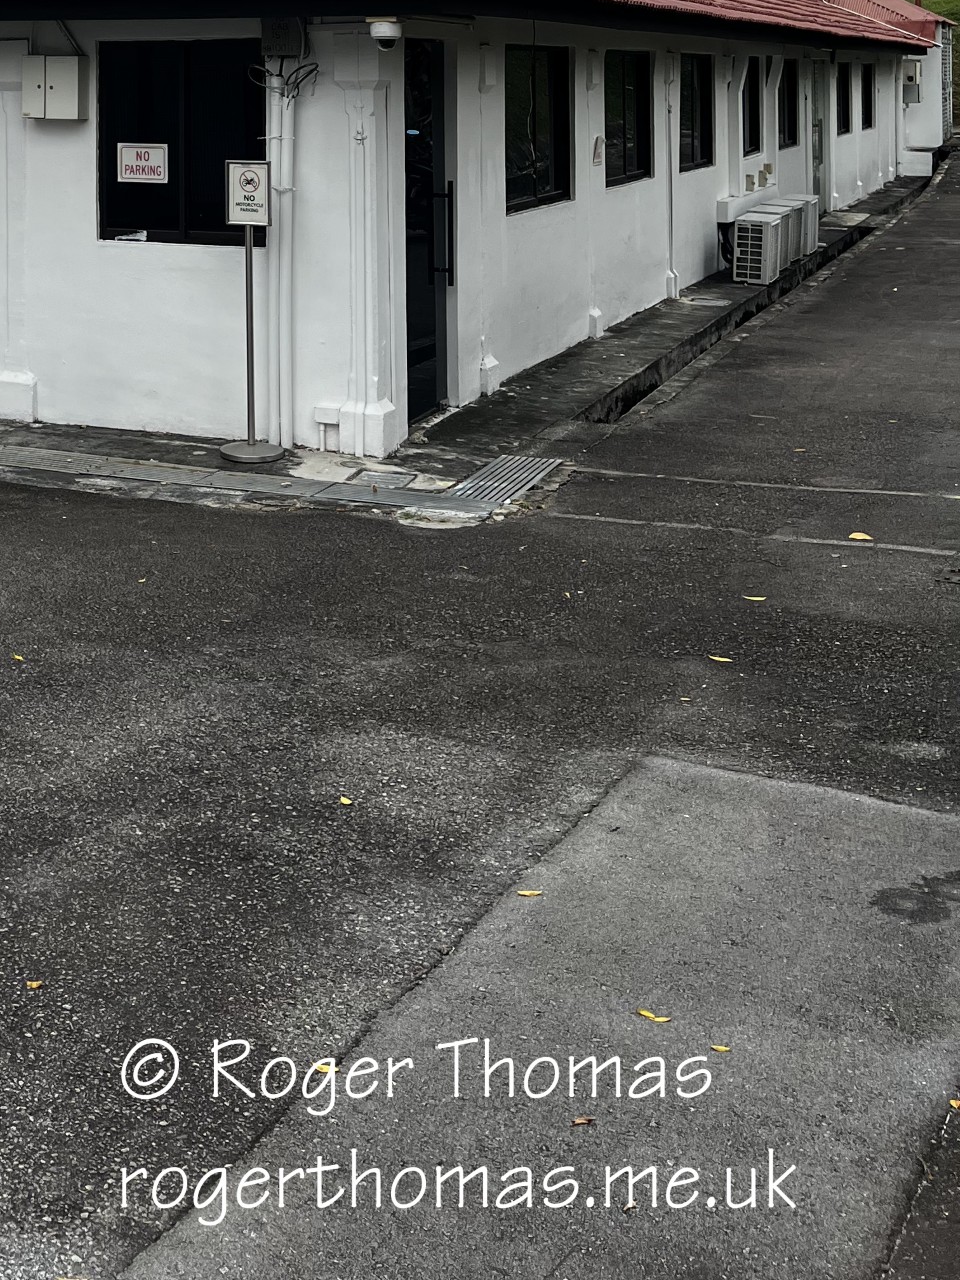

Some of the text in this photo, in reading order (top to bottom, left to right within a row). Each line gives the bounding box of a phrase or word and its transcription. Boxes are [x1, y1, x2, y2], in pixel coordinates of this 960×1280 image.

[135, 150, 150, 162] NO
[124, 164, 162, 177] PARKING
[243, 194, 256, 202] NO
